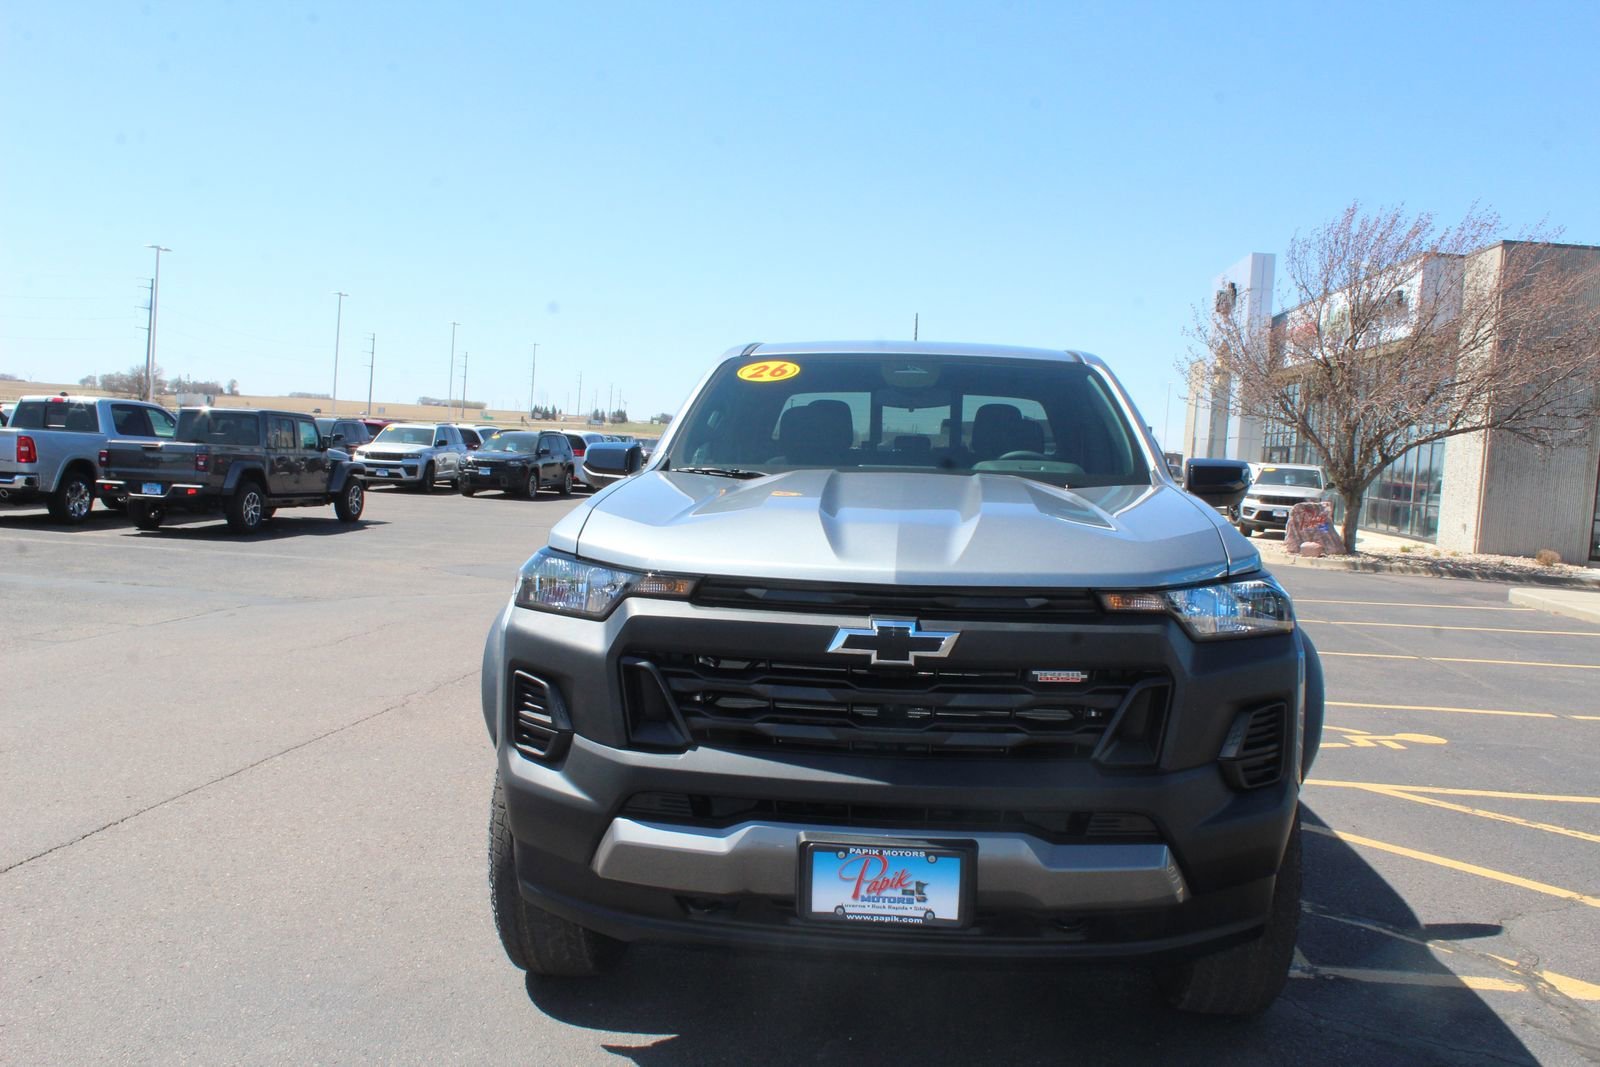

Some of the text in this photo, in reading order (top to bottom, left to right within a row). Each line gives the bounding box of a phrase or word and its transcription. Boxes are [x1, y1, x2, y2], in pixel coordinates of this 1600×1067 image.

[747, 363, 788, 378] 26
[883, 849, 926, 857] MOTORS
[838, 854, 912, 900] Papik
[860, 895, 914, 904] MOTORS
[846, 914, 923, 924] www.papik.com
